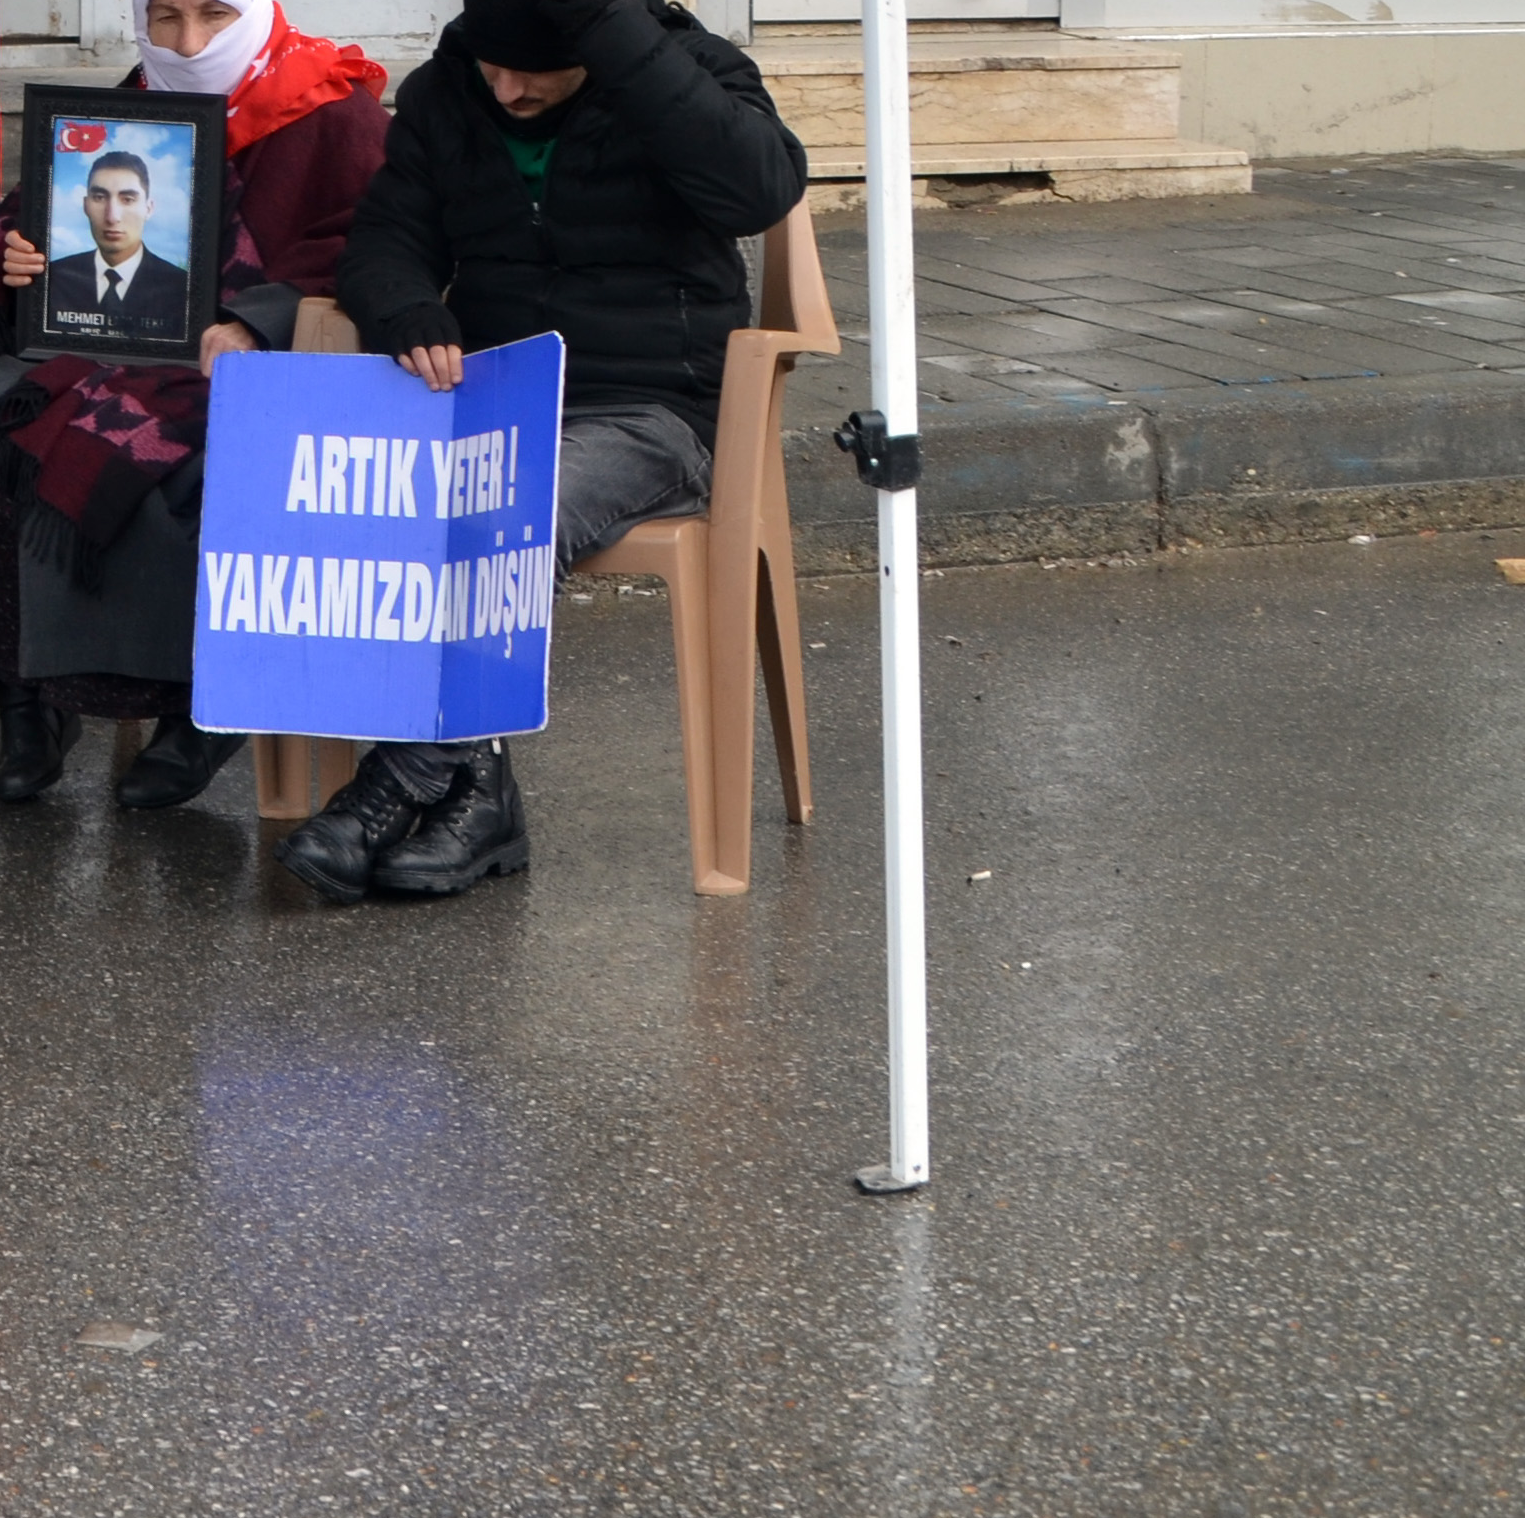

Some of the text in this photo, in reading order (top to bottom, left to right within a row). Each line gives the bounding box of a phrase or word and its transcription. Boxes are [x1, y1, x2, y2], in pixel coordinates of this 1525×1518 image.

[56, 310, 105, 326] MEHMET
[285, 434, 419, 518] ARTIK
[204, 526, 551, 660] YAKAMIZDAN DÜŞÜN
